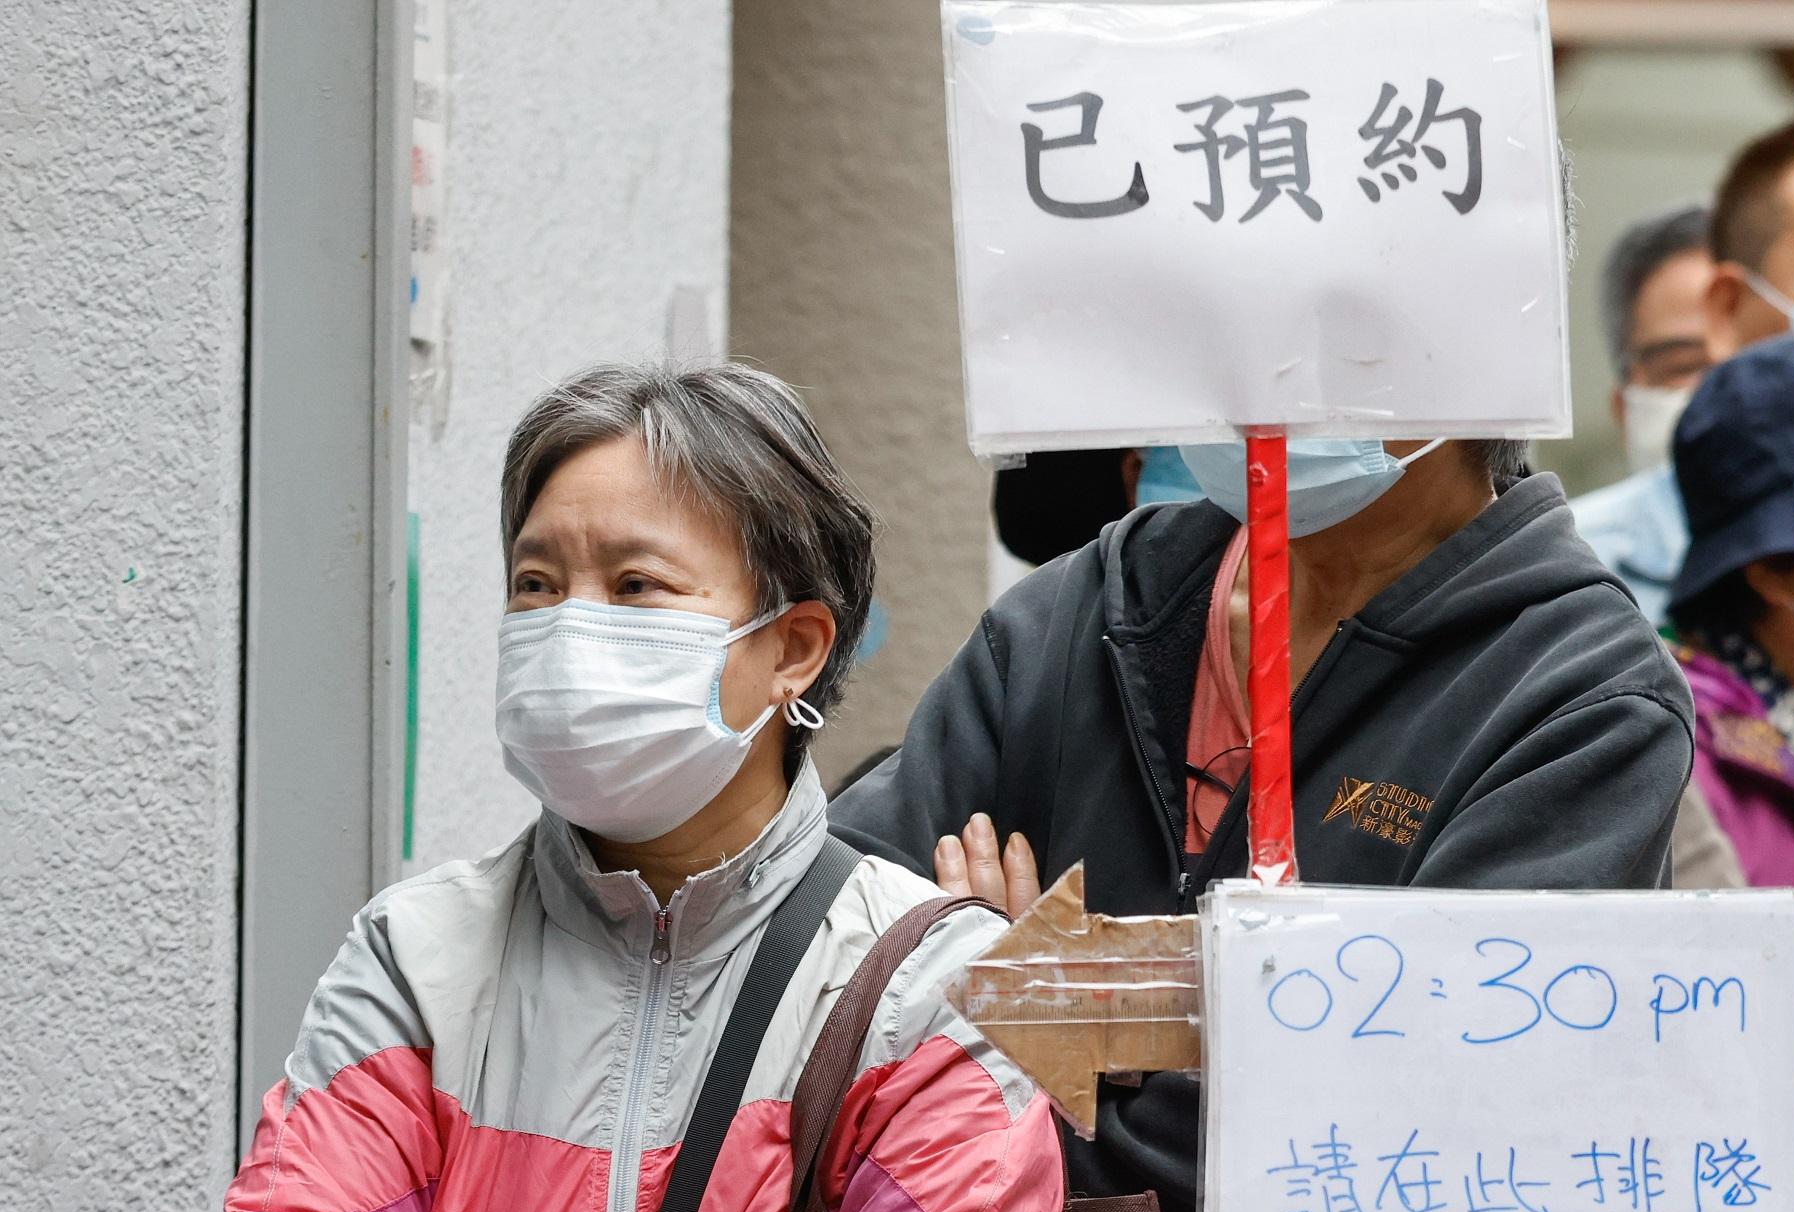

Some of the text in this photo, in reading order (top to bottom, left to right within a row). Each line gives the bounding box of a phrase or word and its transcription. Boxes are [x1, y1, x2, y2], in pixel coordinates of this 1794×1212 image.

[1019, 77, 1484, 224] 已預約
[1360, 814, 1417, 849] 新濠影
[1370, 799, 1411, 824] CITY
[1267, 933, 1747, 1044] 02:30 pm
